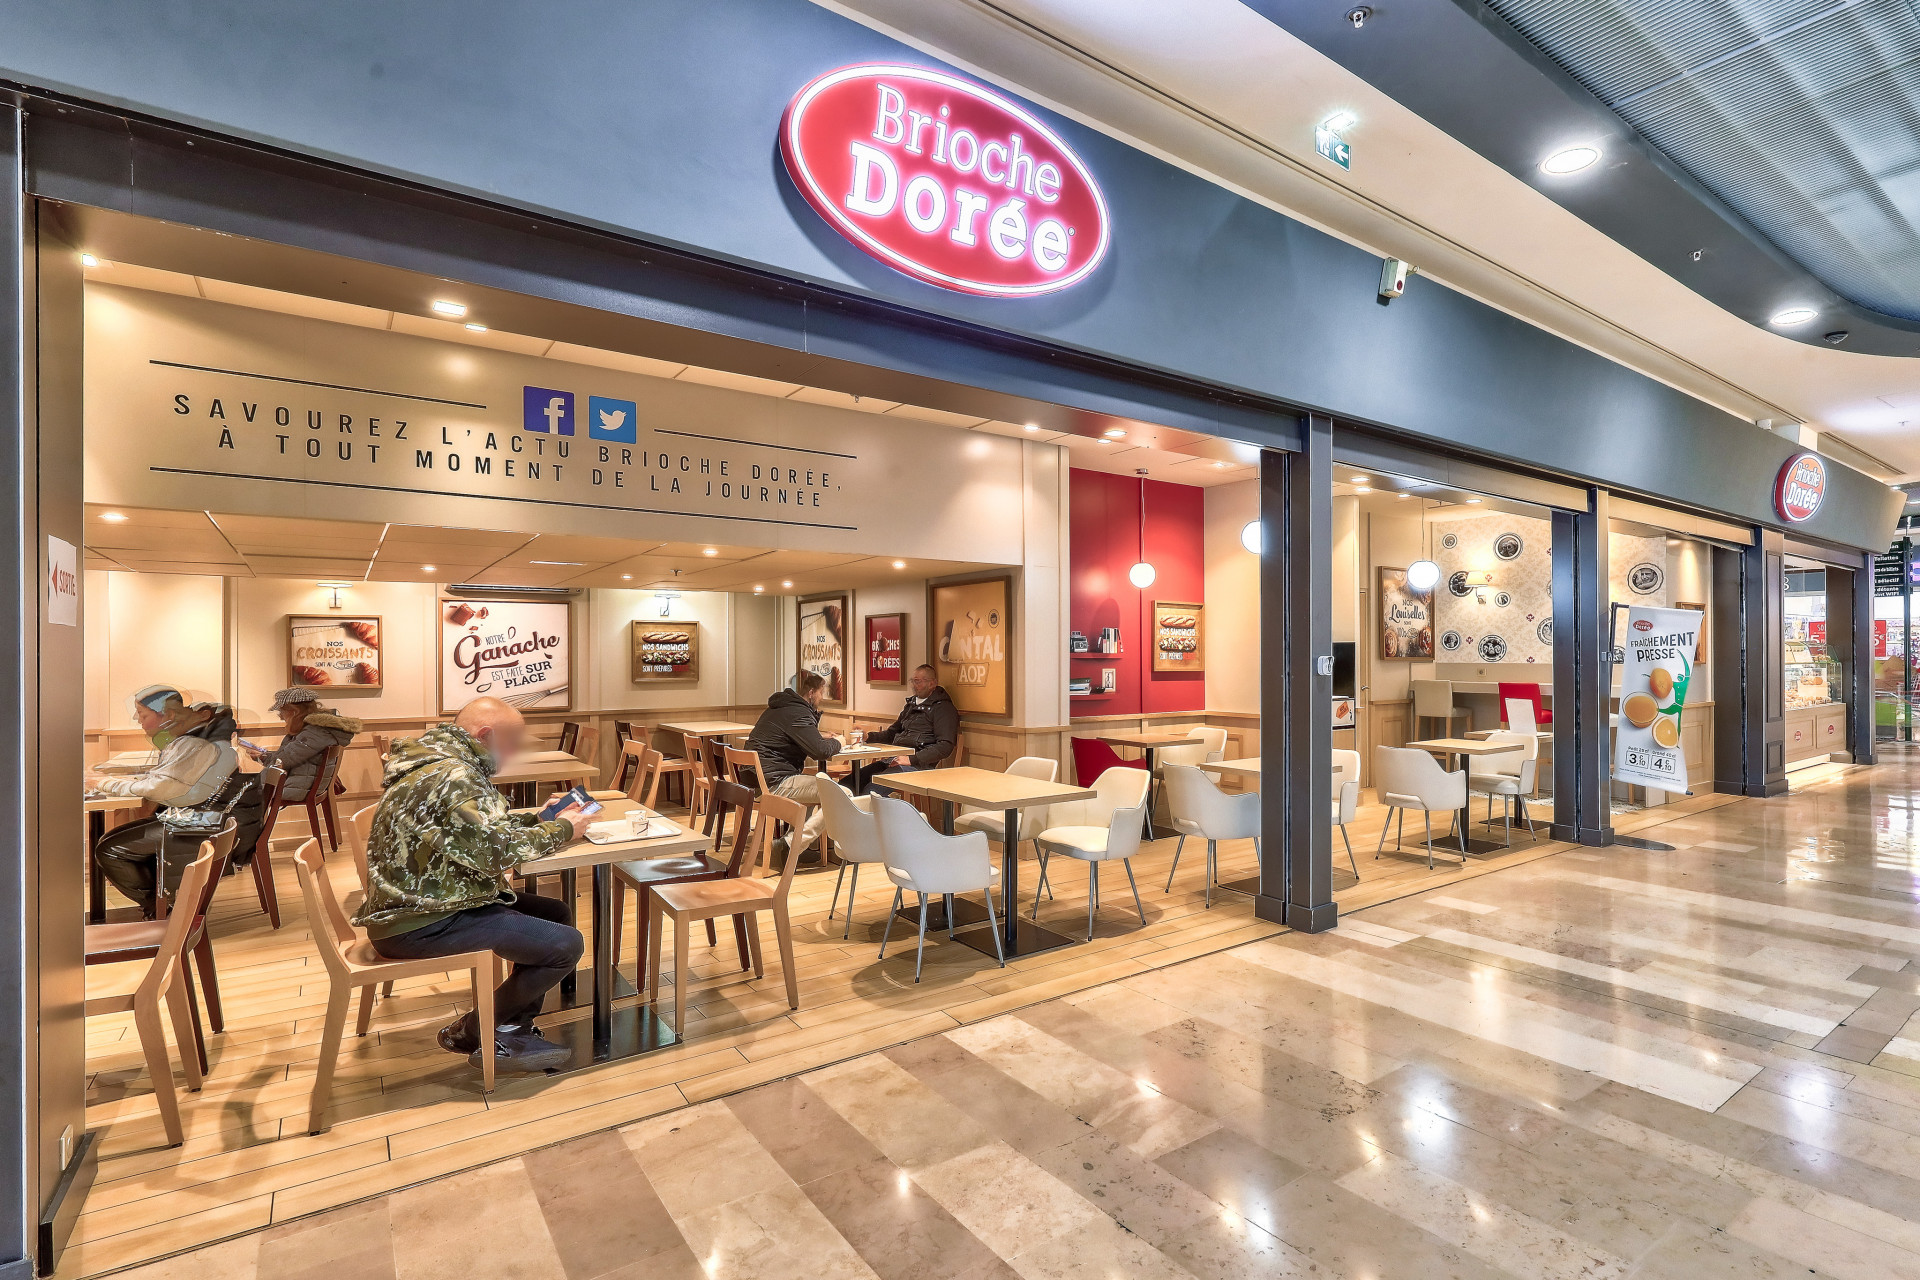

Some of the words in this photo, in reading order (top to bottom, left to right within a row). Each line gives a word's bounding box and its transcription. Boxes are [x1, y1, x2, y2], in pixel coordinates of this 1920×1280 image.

[872, 83, 1061, 203] Brioche
[846, 141, 1069, 272] Dorée
[173, 394, 408, 440] SAVOUREZ
[442, 426, 570, 459] L'ACTU
[599, 446, 729, 477] BRIOCHE
[752, 464, 842, 492] DORÉE,
[218, 424, 235, 450] À
[276, 434, 380, 464] TOUT
[415, 449, 563, 482] MOMENT
[592, 468, 624, 488] DE
[650, 477, 681, 494] LA
[706, 480, 821, 507] JOURNÉE
[1795, 462, 1820, 488] Brioche
[1786, 481, 1819, 511] Dorée
[59, 569, 76, 597] SORTIE
[485, 633, 507, 646] NOTRE
[642, 643, 655, 651] NOS
[816, 635, 826, 643] NOS
[296, 646, 374, 660] CROISSANTS
[453, 631, 561, 685] Ganache
[803, 642, 842, 661] CROISSANTS
[872, 655, 900, 669] DRÉES
[491, 670, 504, 682] EST
[506, 666, 524, 678] FAITE
[525, 660, 553, 674] SUR
[504, 672, 547, 689] PLACE
[958, 665, 986, 683] AOP
